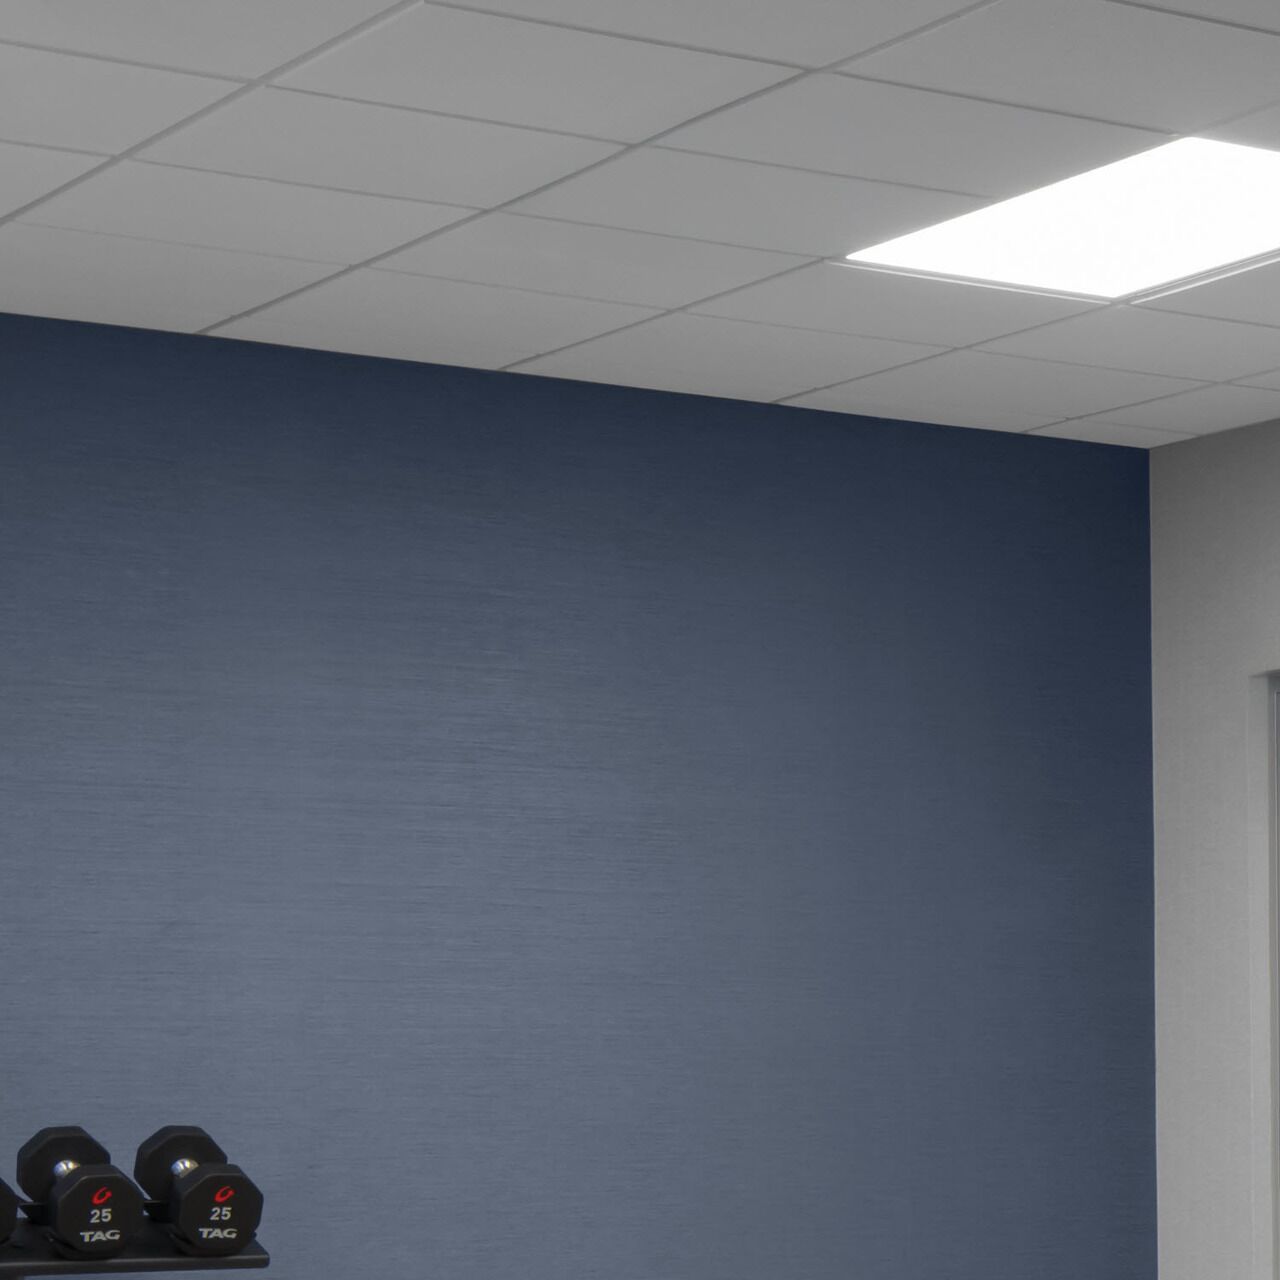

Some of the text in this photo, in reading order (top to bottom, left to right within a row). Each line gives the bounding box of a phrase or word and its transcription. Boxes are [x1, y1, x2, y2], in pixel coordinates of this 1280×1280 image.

[90, 1207, 113, 1224] 25
[210, 1206, 232, 1222] 25
[79, 1229, 121, 1243] TAG
[198, 1227, 238, 1240] TAG
